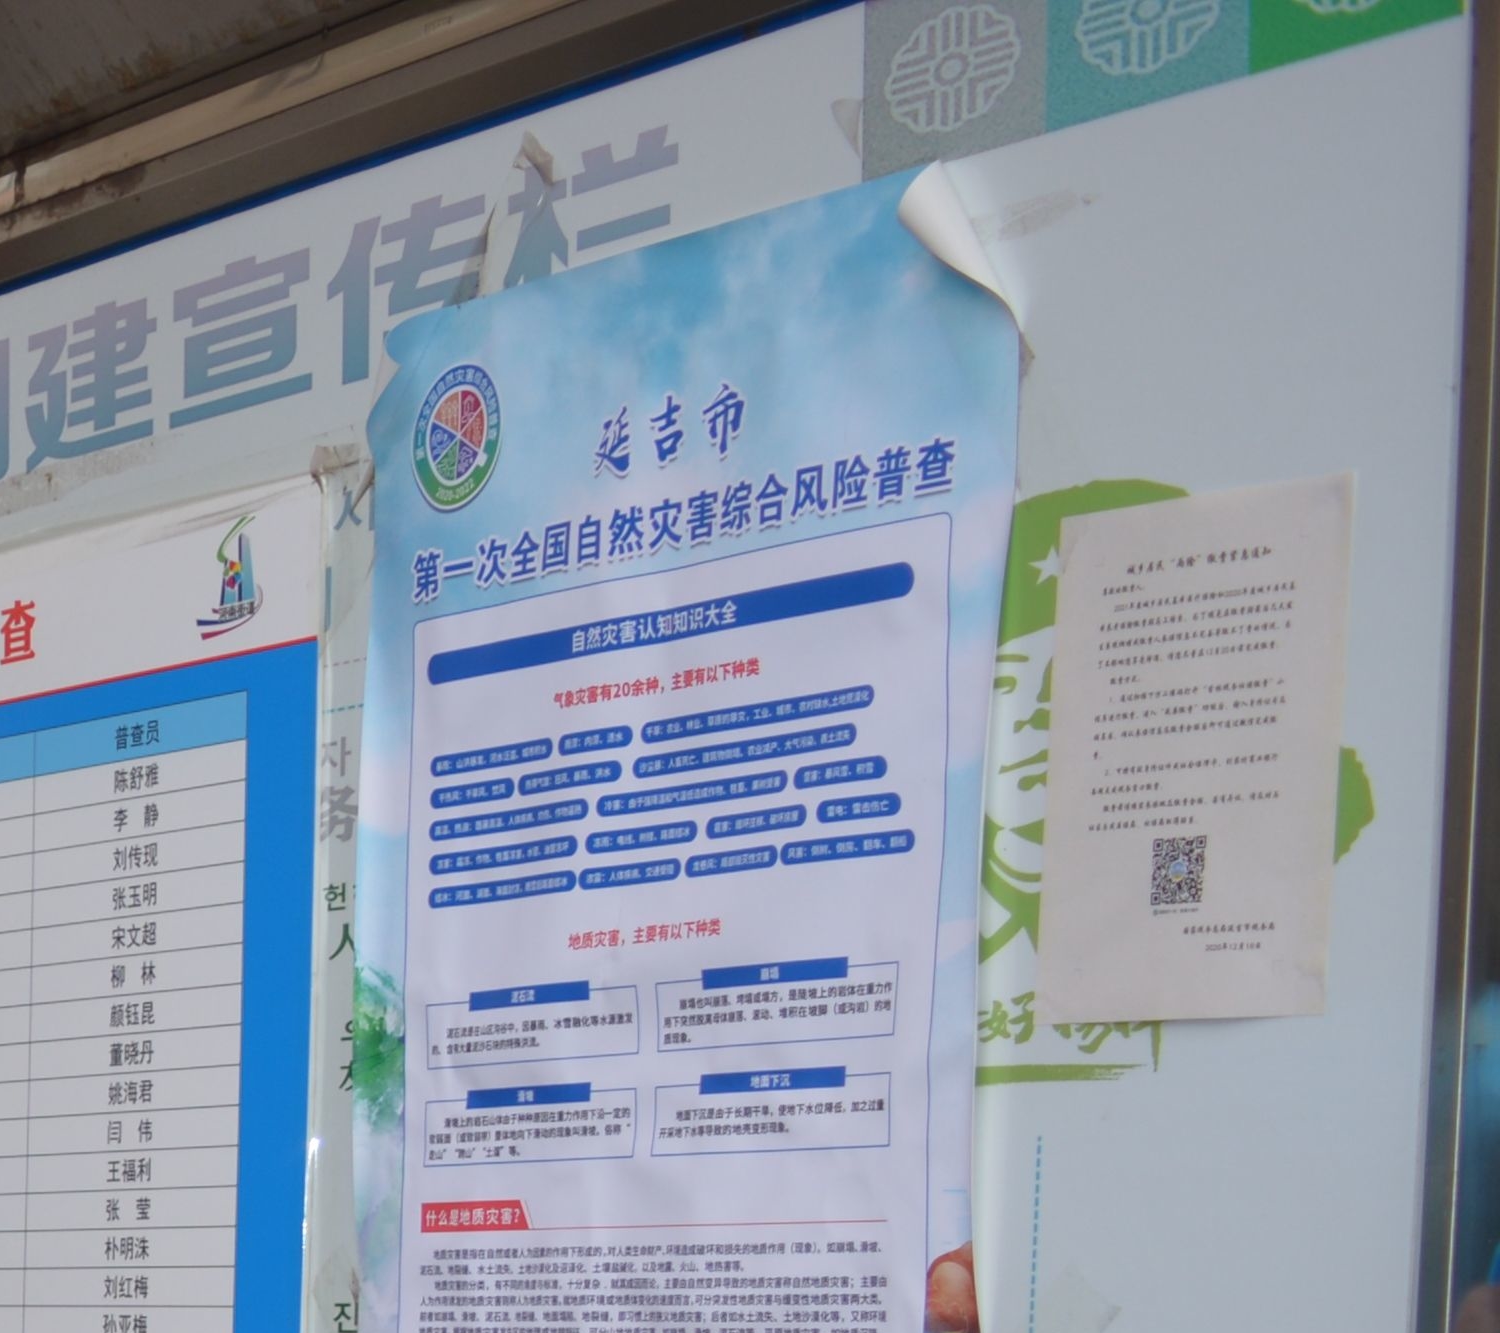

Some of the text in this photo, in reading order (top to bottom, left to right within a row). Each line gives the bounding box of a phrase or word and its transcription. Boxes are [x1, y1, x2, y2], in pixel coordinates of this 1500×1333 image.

[594, 382, 746, 473] 延吉市
[411, 437, 957, 603] 第一次全国自然灾害综合风险普查
[572, 599, 738, 653] 自然灾害认知知识大全
[115, 721, 160, 751] 普查员
[113, 763, 159, 793] 陈舒雅
[112, 841, 159, 871] 刘传现
[111, 881, 158, 911] 张玉明
[111, 921, 157, 950] 宋文超
[109, 1000, 156, 1028] 颜钰昆
[109, 1039, 155, 1068] 董晓丹
[108, 1079, 154, 1106] 姚海君
[106, 1157, 152, 1183] 王福利
[425, 1207, 521, 1228] 什么是地质灾害？
[104, 1236, 150, 1261] 朴明洙
[103, 1275, 149, 1300] 刘红梅
